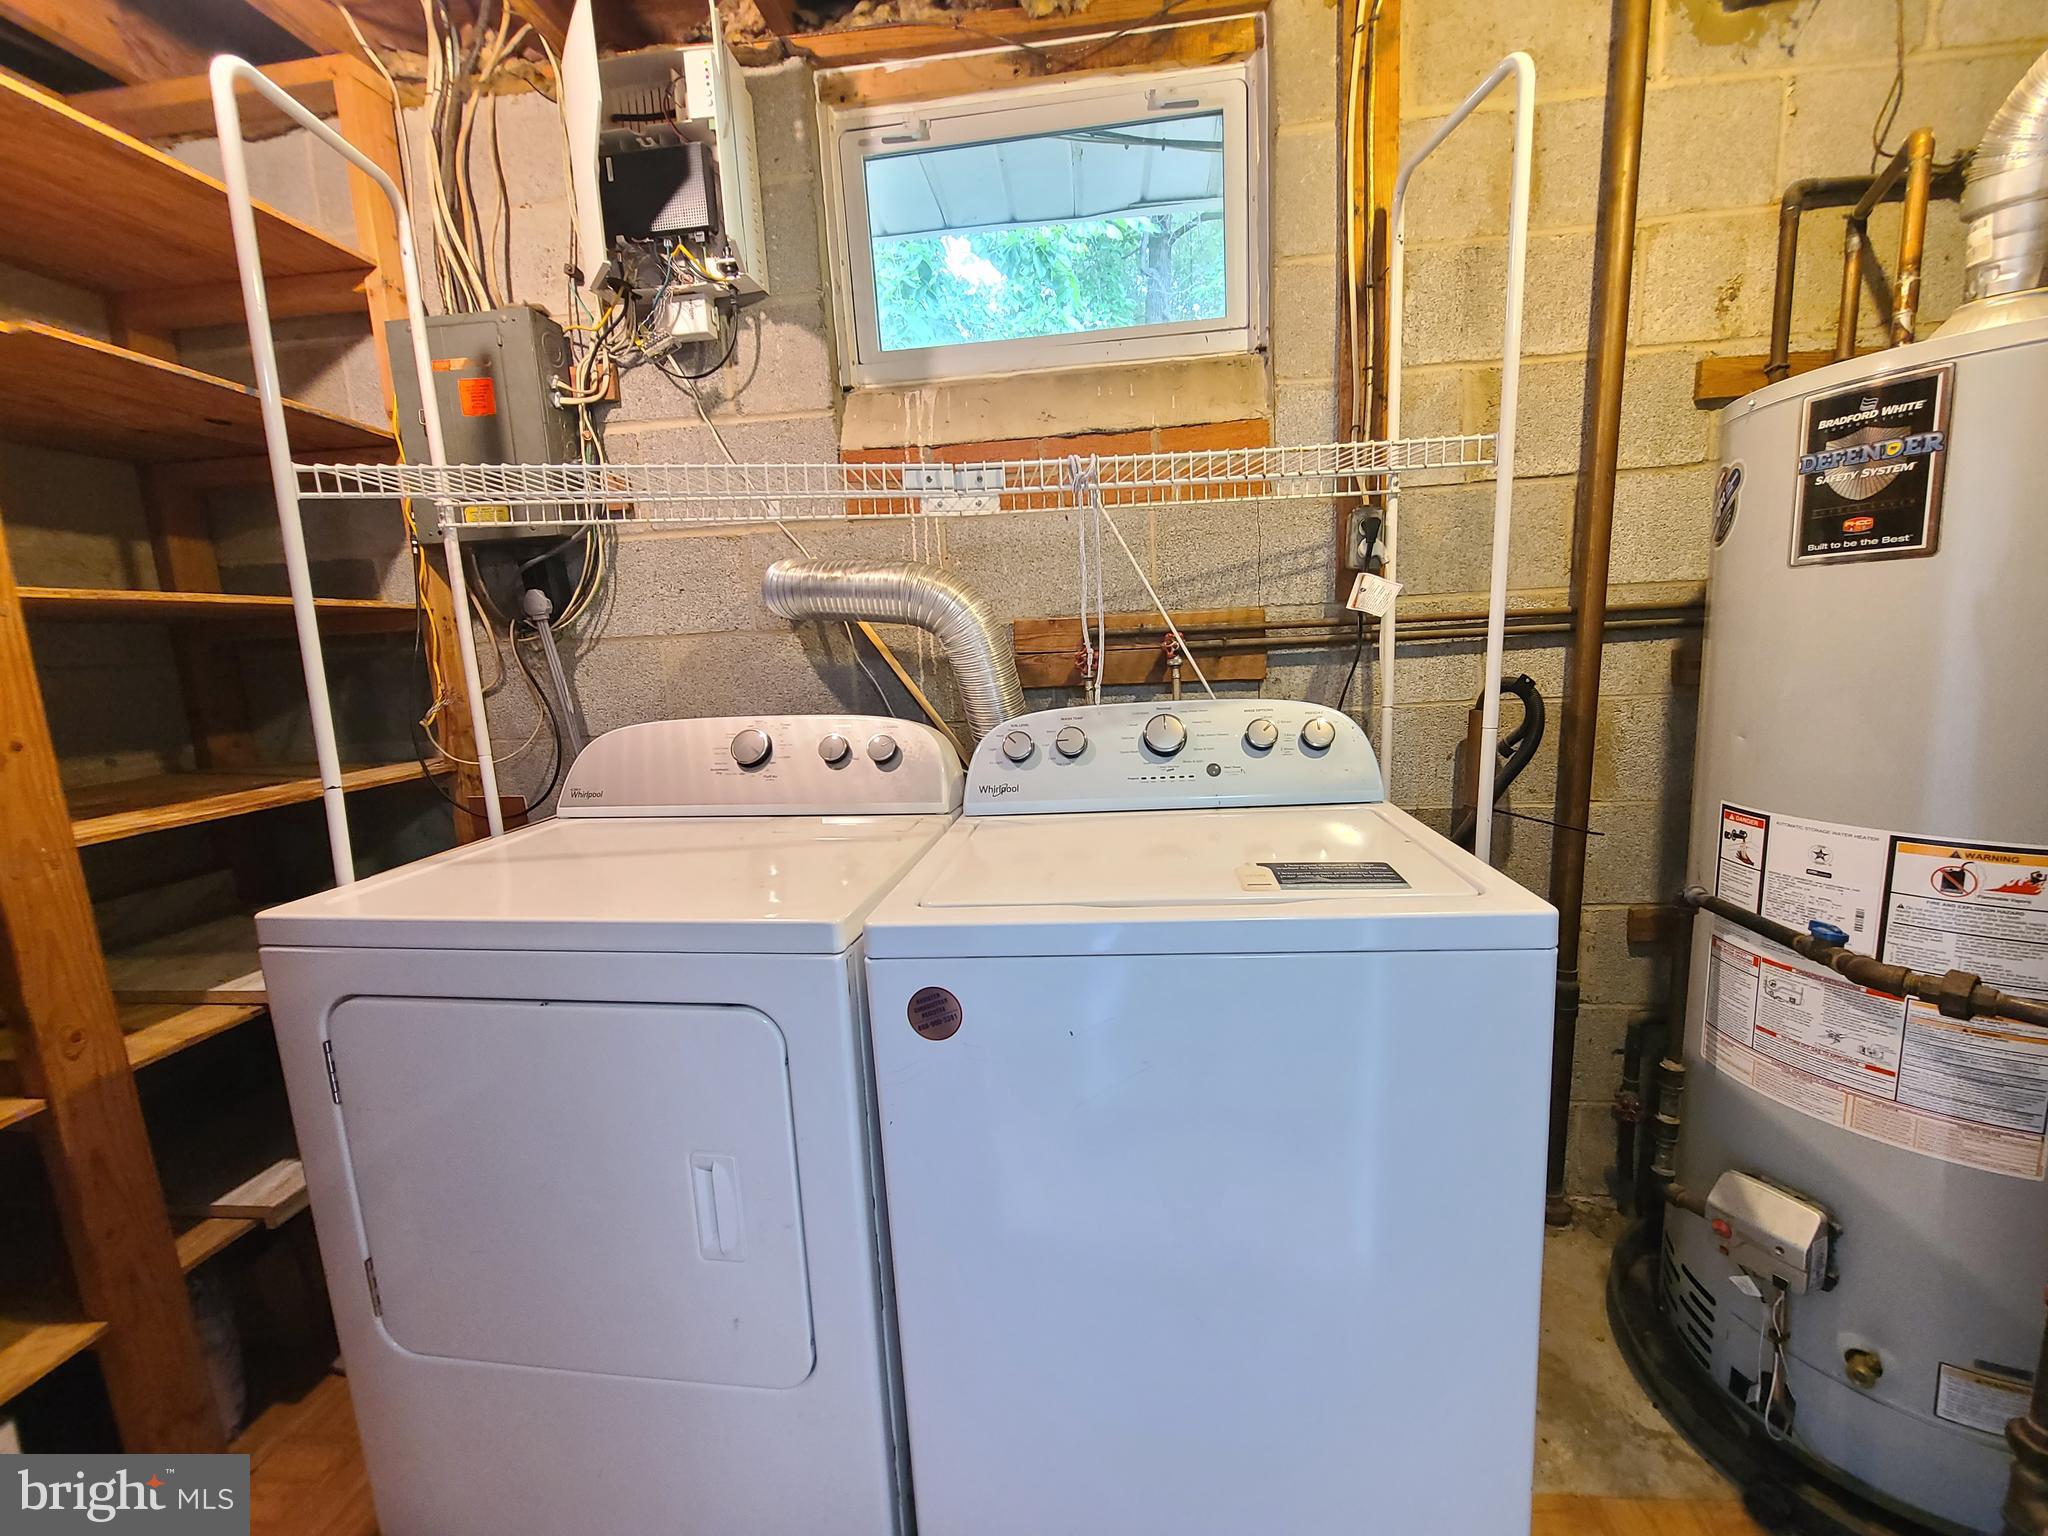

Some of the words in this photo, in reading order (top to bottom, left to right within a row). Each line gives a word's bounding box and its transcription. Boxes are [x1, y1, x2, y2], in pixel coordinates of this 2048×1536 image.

[1818, 409, 1879, 430] BRADFORD
[1881, 400, 1925, 416] WHITE
[1800, 431, 1944, 475] DEFENDER
[1814, 470, 1859, 486] SAFETY
[1860, 462, 1915, 478] SYSTEM
[1808, 543, 1828, 552] Built
[1830, 541, 1841, 549] to
[1843, 540, 1857, 548] be
[1860, 537, 1879, 546] the
[1882, 534, 1910, 544] Best
[570, 790, 604, 800] Whirlpool
[979, 784, 1019, 797] Whirlpool
[1736, 815, 1759, 827] DANGER
[1965, 852, 2020, 864] WARNING
